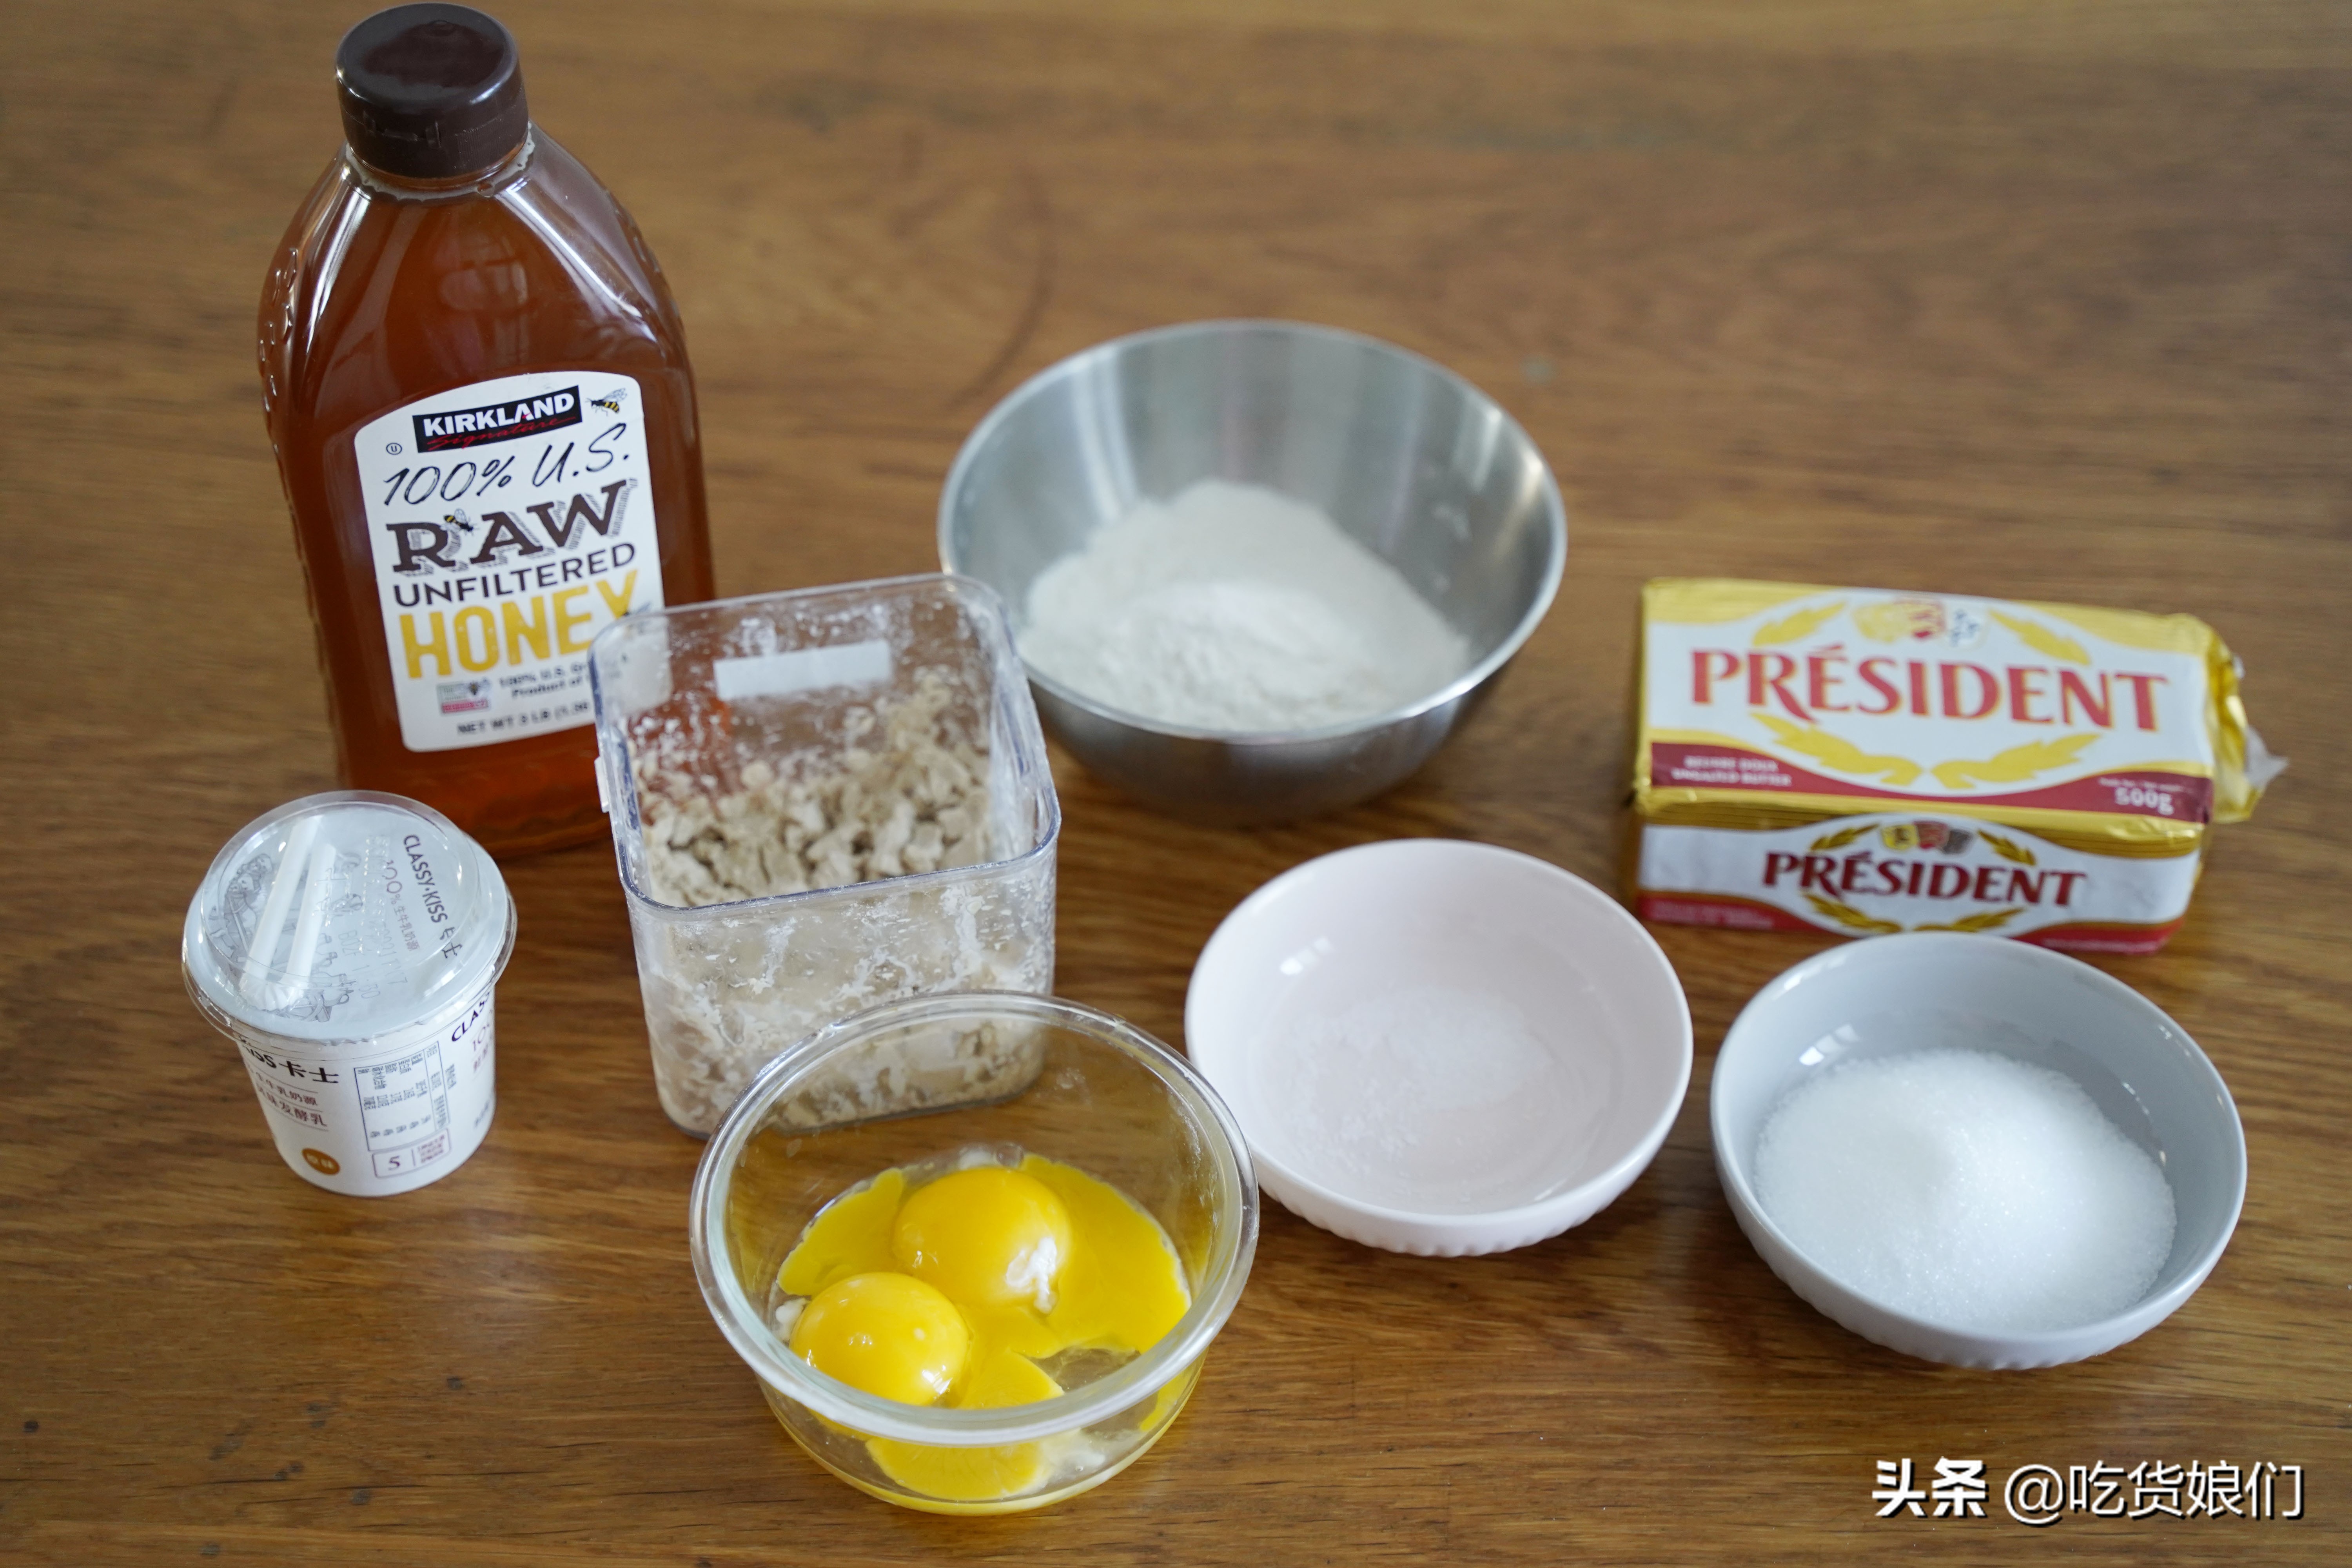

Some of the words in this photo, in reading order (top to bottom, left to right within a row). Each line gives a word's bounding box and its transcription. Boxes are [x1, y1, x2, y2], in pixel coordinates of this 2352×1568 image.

[423, 392, 575, 437] KIRKLAND
[427, 414, 576, 450] Signature
[383, 455, 515, 505] 100%
[532, 423, 630, 488] U.S.
[387, 478, 636, 575] RAW
[394, 543, 635, 607] UNFILTERED
[399, 570, 638, 679] HONEY
[1690, 643, 2169, 732] PRÉSIDENT
[457, 720, 486, 734] NET
[2115, 787, 2174, 816] 500g
[1762, 849, 2088, 906] PRÉSIDENT
[279, 1060, 339, 1083] 卡士
